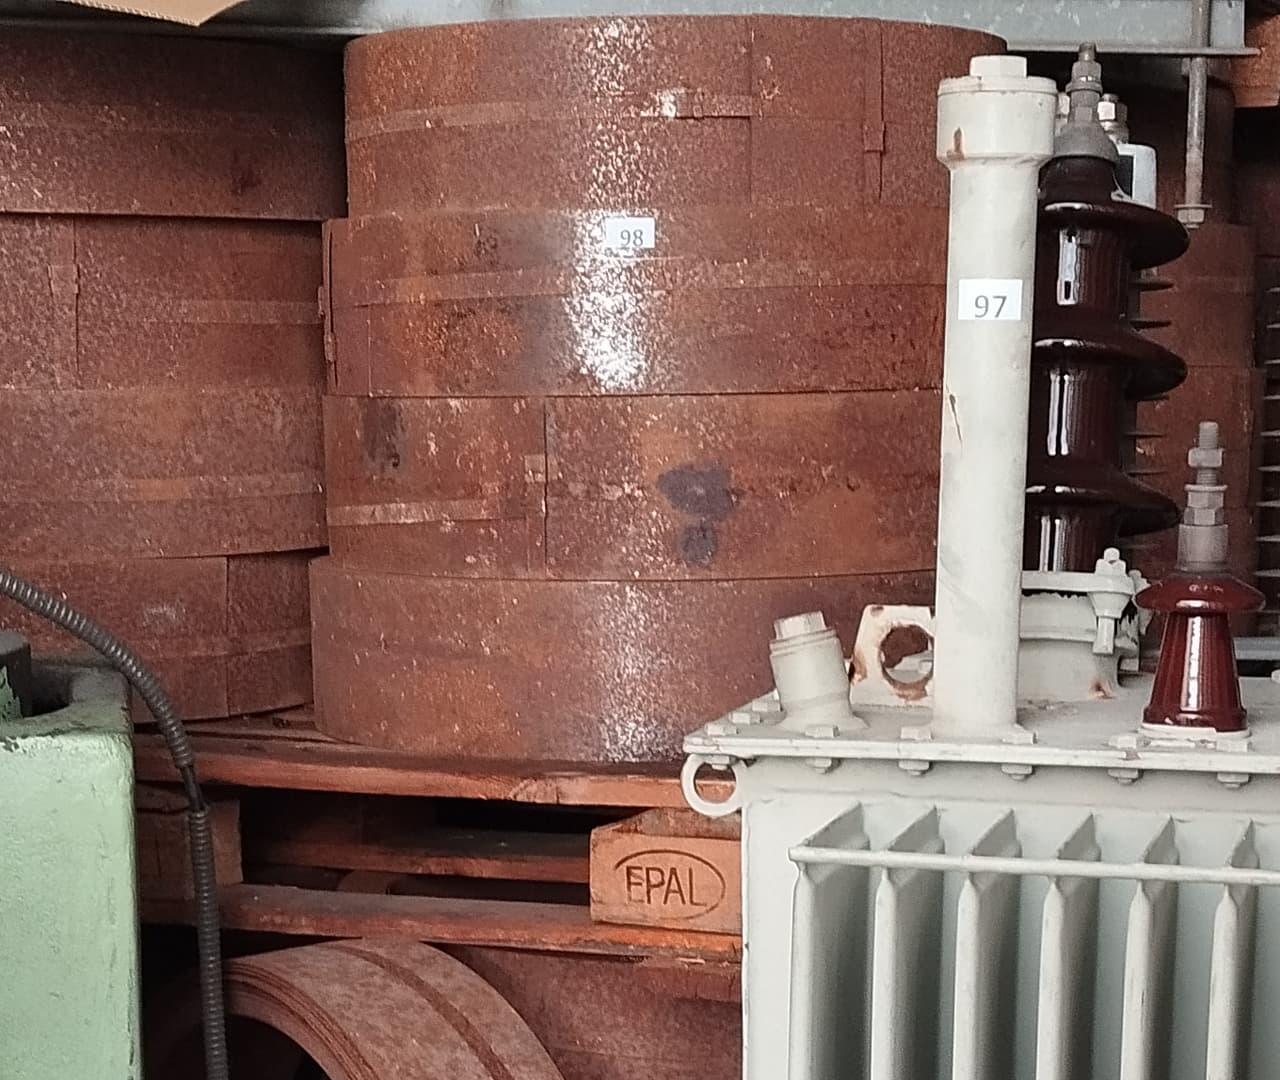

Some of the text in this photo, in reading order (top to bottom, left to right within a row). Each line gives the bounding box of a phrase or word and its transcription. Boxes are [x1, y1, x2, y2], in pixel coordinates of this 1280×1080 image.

[620, 229, 644, 247] 98
[975, 295, 1007, 318] 97
[625, 866, 707, 905] EPAL
